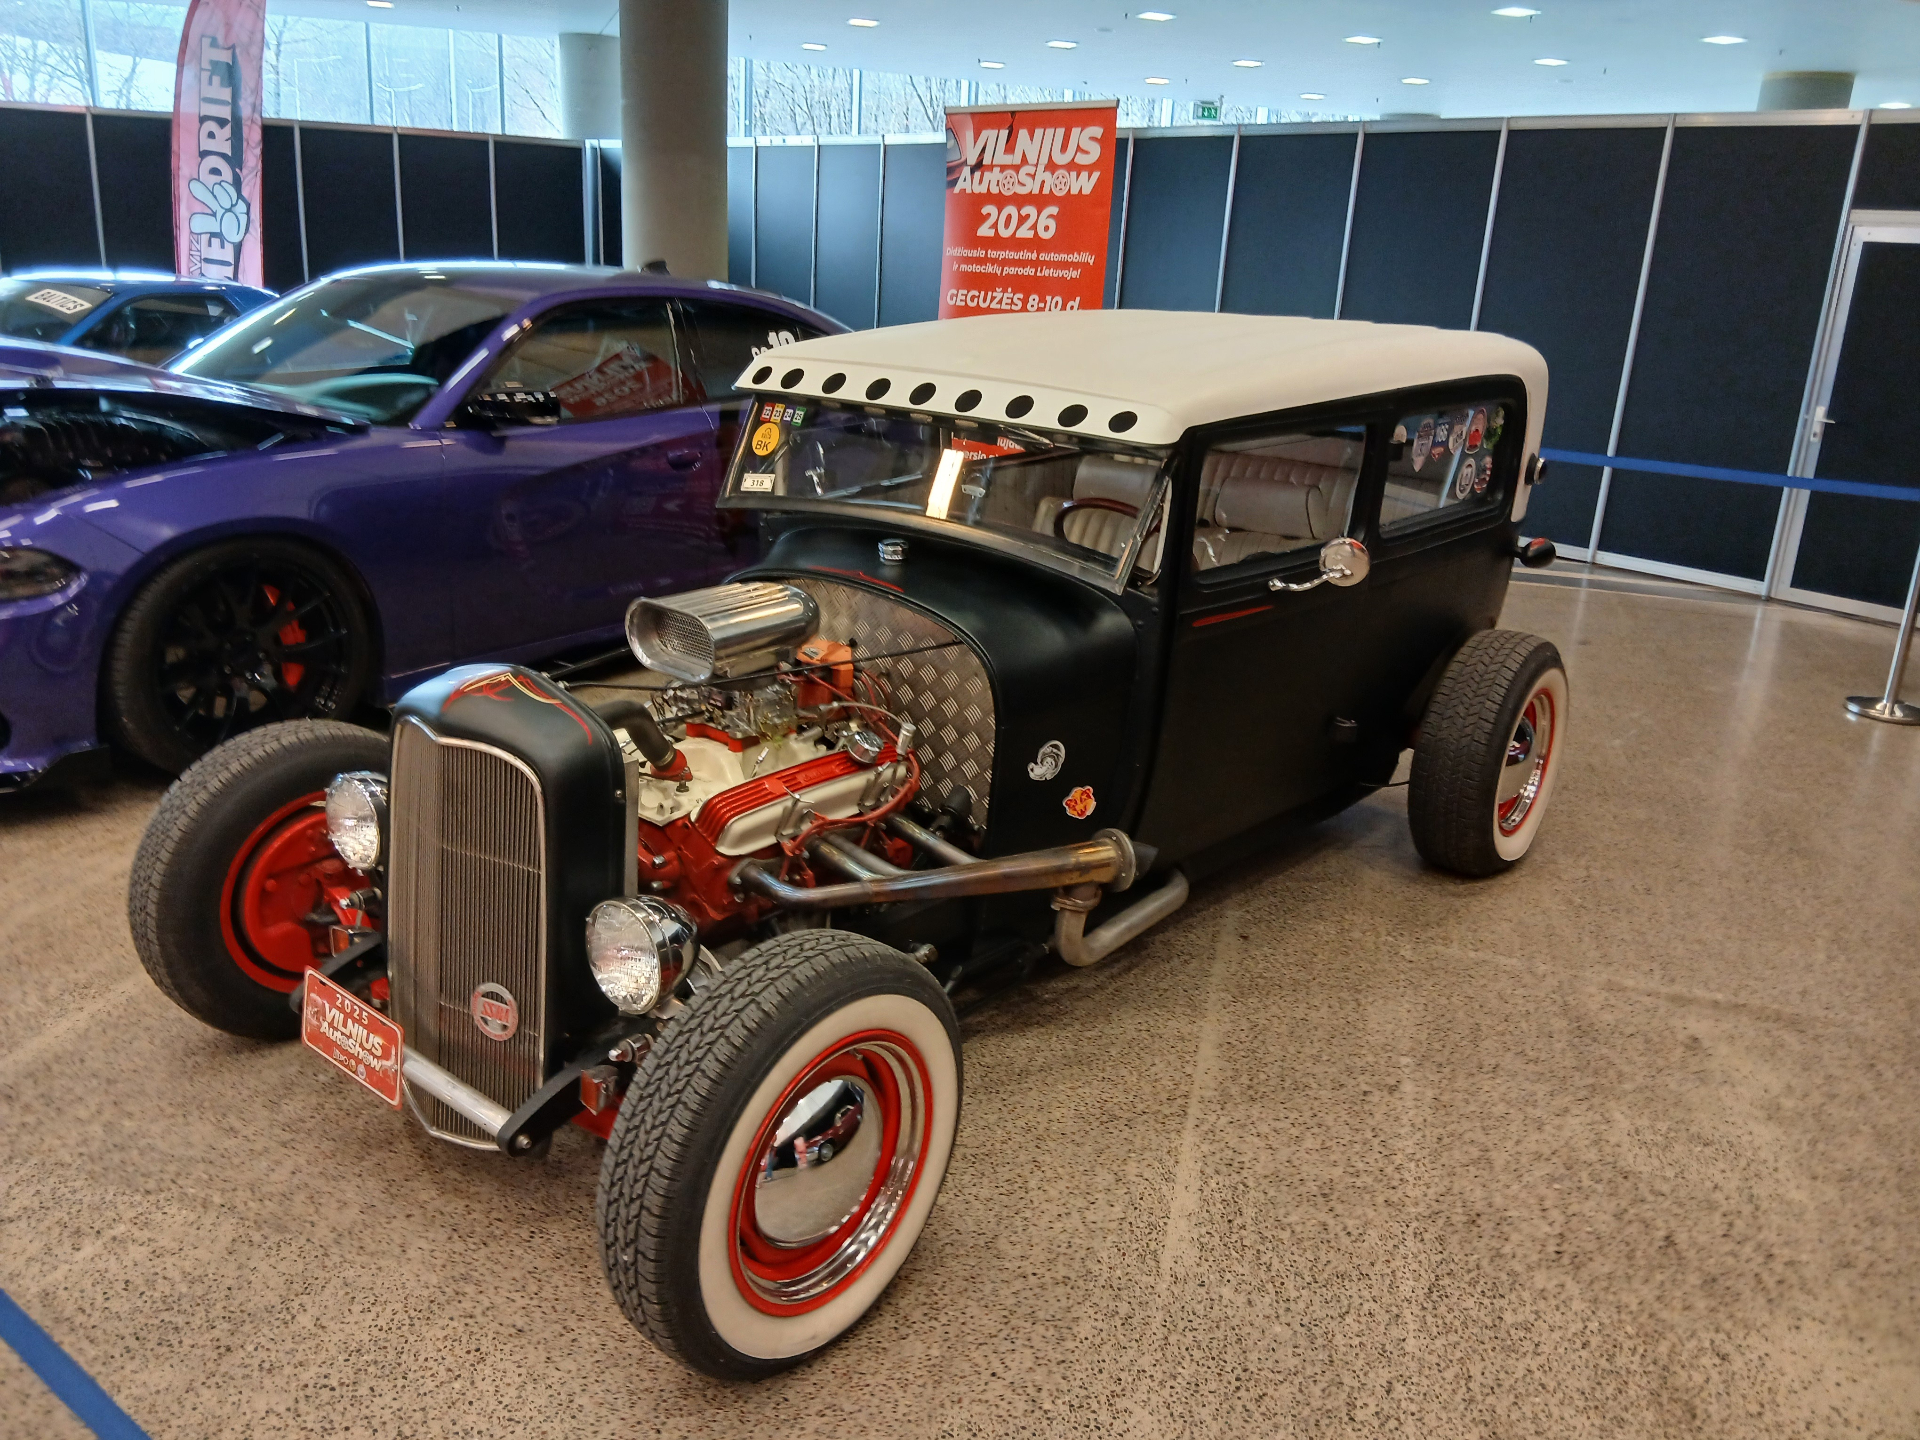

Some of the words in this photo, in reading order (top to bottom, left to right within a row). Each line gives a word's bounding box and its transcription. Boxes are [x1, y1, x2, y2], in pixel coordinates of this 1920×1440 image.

[199, 36, 234, 186] DRIFT
[965, 126, 1104, 165] VILNIUS
[953, 164, 1100, 196] AutoShow
[976, 204, 1060, 239] 2026
[946, 246, 985, 258] Didžiausia
[987, 249, 1037, 261] tarptautinė
[1039, 251, 1095, 266] automobilių
[952, 261, 959, 271] ir
[959, 263, 1001, 276] motociklų
[1002, 265, 1035, 276] paroda
[1036, 266, 1081, 281] Lietuvoje!
[946, 287, 1024, 311] GEGUŽĖS
[1026, 294, 1063, 312] 8-10
[763, 407, 772, 416] 22
[773, 410, 781, 418] 23
[785, 411, 793, 419] 24
[795, 413, 803, 421] 25
[755, 440, 771, 452] BK
[750, 479, 765, 487] 318
[335, 993, 369, 1025] 2025
[320, 1020, 382, 1072] AutoShow
[324, 1003, 383, 1057] VILNIUS
